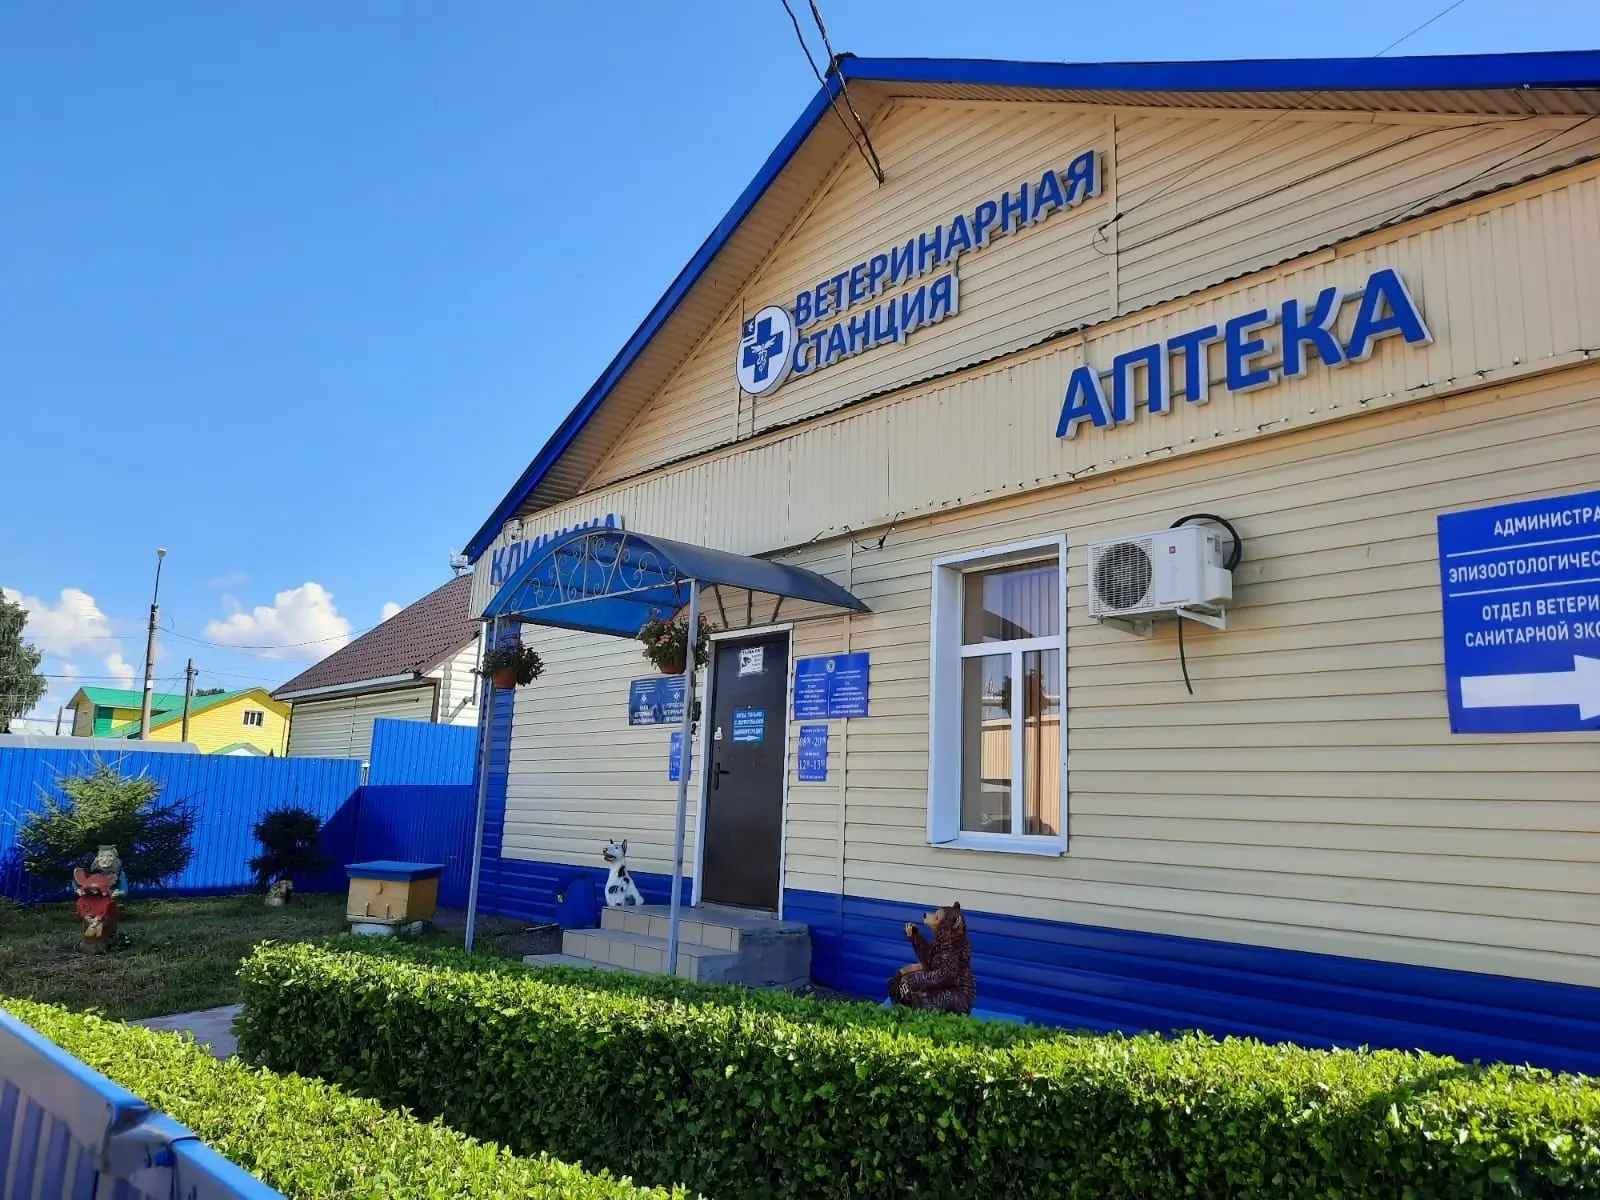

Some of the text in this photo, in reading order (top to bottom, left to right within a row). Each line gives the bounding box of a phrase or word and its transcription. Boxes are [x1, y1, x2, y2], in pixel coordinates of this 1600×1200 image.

[795, 150, 1100, 329] ВЕТЕРИНАРНАЯ
[792, 273, 958, 375] СТАНЦИЯ
[1055, 267, 1432, 440] АПТЕКА
[1448, 550, 1600, 584] ЭПИЗООТОЛОГИЧЕС
[1465, 620, 1569, 648] САНИТАРНОЙ
[1482, 594, 1600, 623] ОТДЕЛ ВЕТЕРИ
